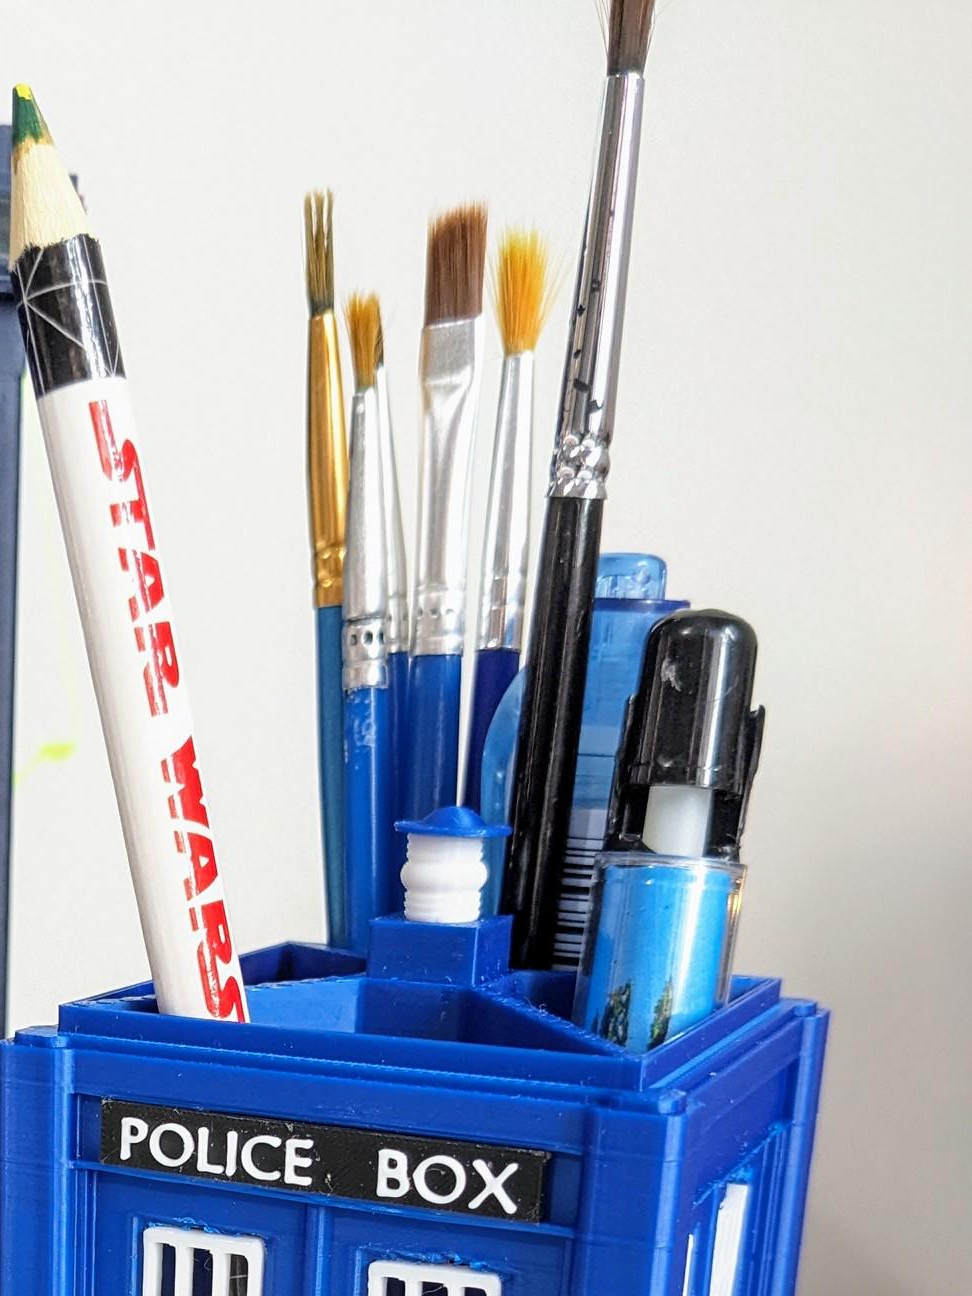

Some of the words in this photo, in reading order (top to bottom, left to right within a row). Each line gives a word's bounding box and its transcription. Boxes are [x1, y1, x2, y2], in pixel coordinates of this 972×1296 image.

[88, 400, 180, 717] STAR
[120, 1117, 315, 1187] POLICE
[376, 1149, 518, 1215] BOX
